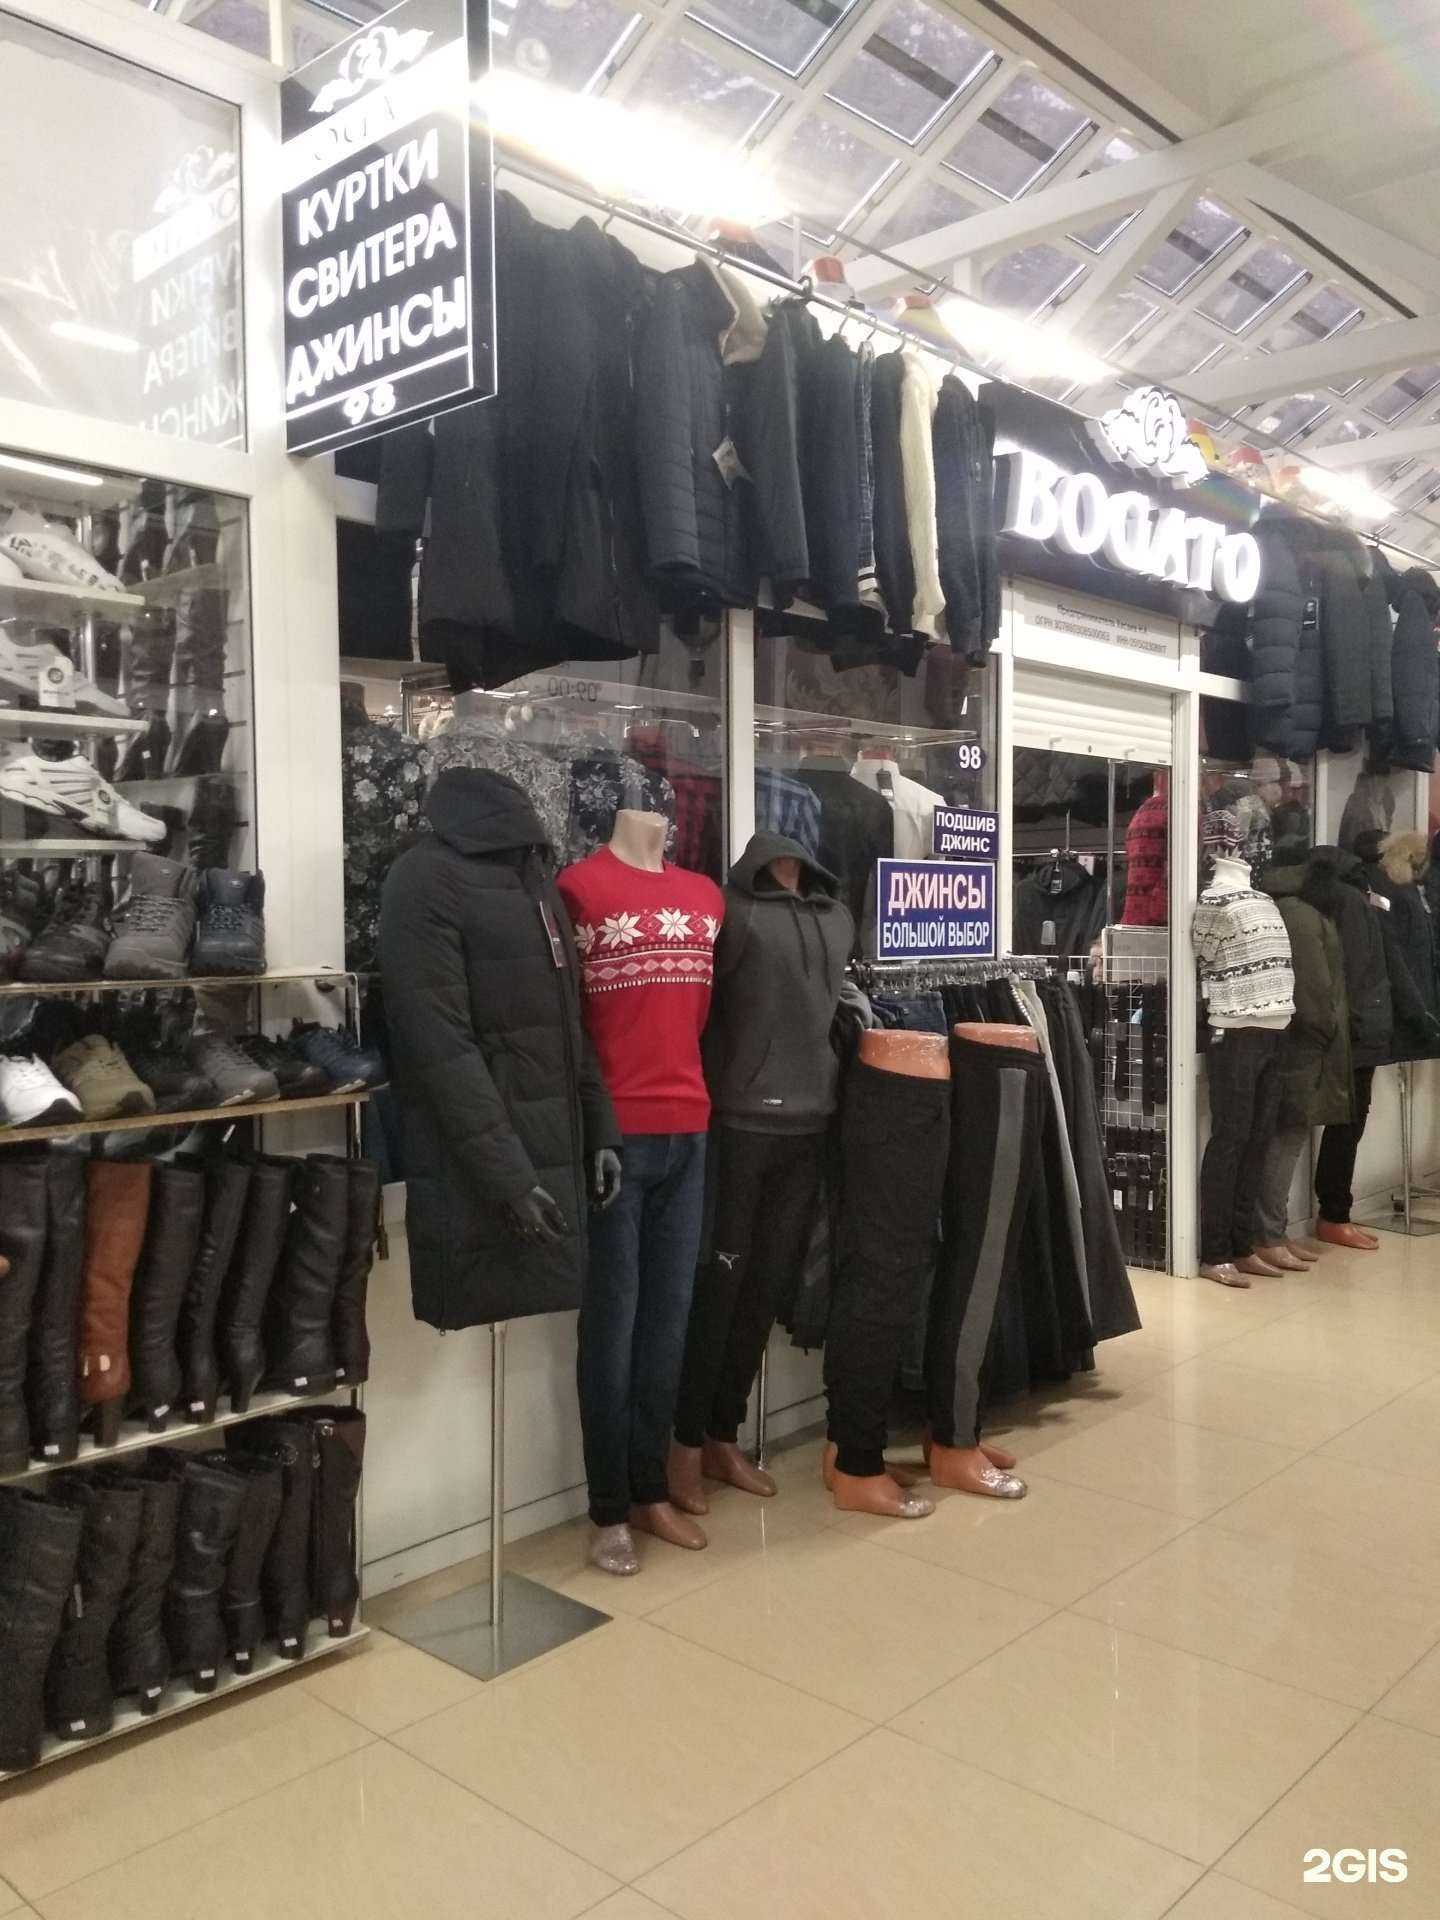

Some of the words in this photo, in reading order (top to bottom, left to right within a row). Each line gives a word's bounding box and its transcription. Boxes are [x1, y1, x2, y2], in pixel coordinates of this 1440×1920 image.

[299, 128, 438, 246] КУРТКИ
[288, 202, 457, 318] СВИТЕРА
[286, 276, 466, 404] ДЖИНСЫ
[343, 382, 396, 425] 98
[1003, 450, 1261, 602] BOGATO
[959, 744, 981, 769] 98
[936, 811, 996, 832] ПОДШИВ
[941, 833, 990, 852] ДЖИНС
[888, 872, 986, 916] ДЖИНСЫ
[883, 916, 945, 948] БОЛЬШОЙ
[948, 921, 989, 947] ВЫБОР
